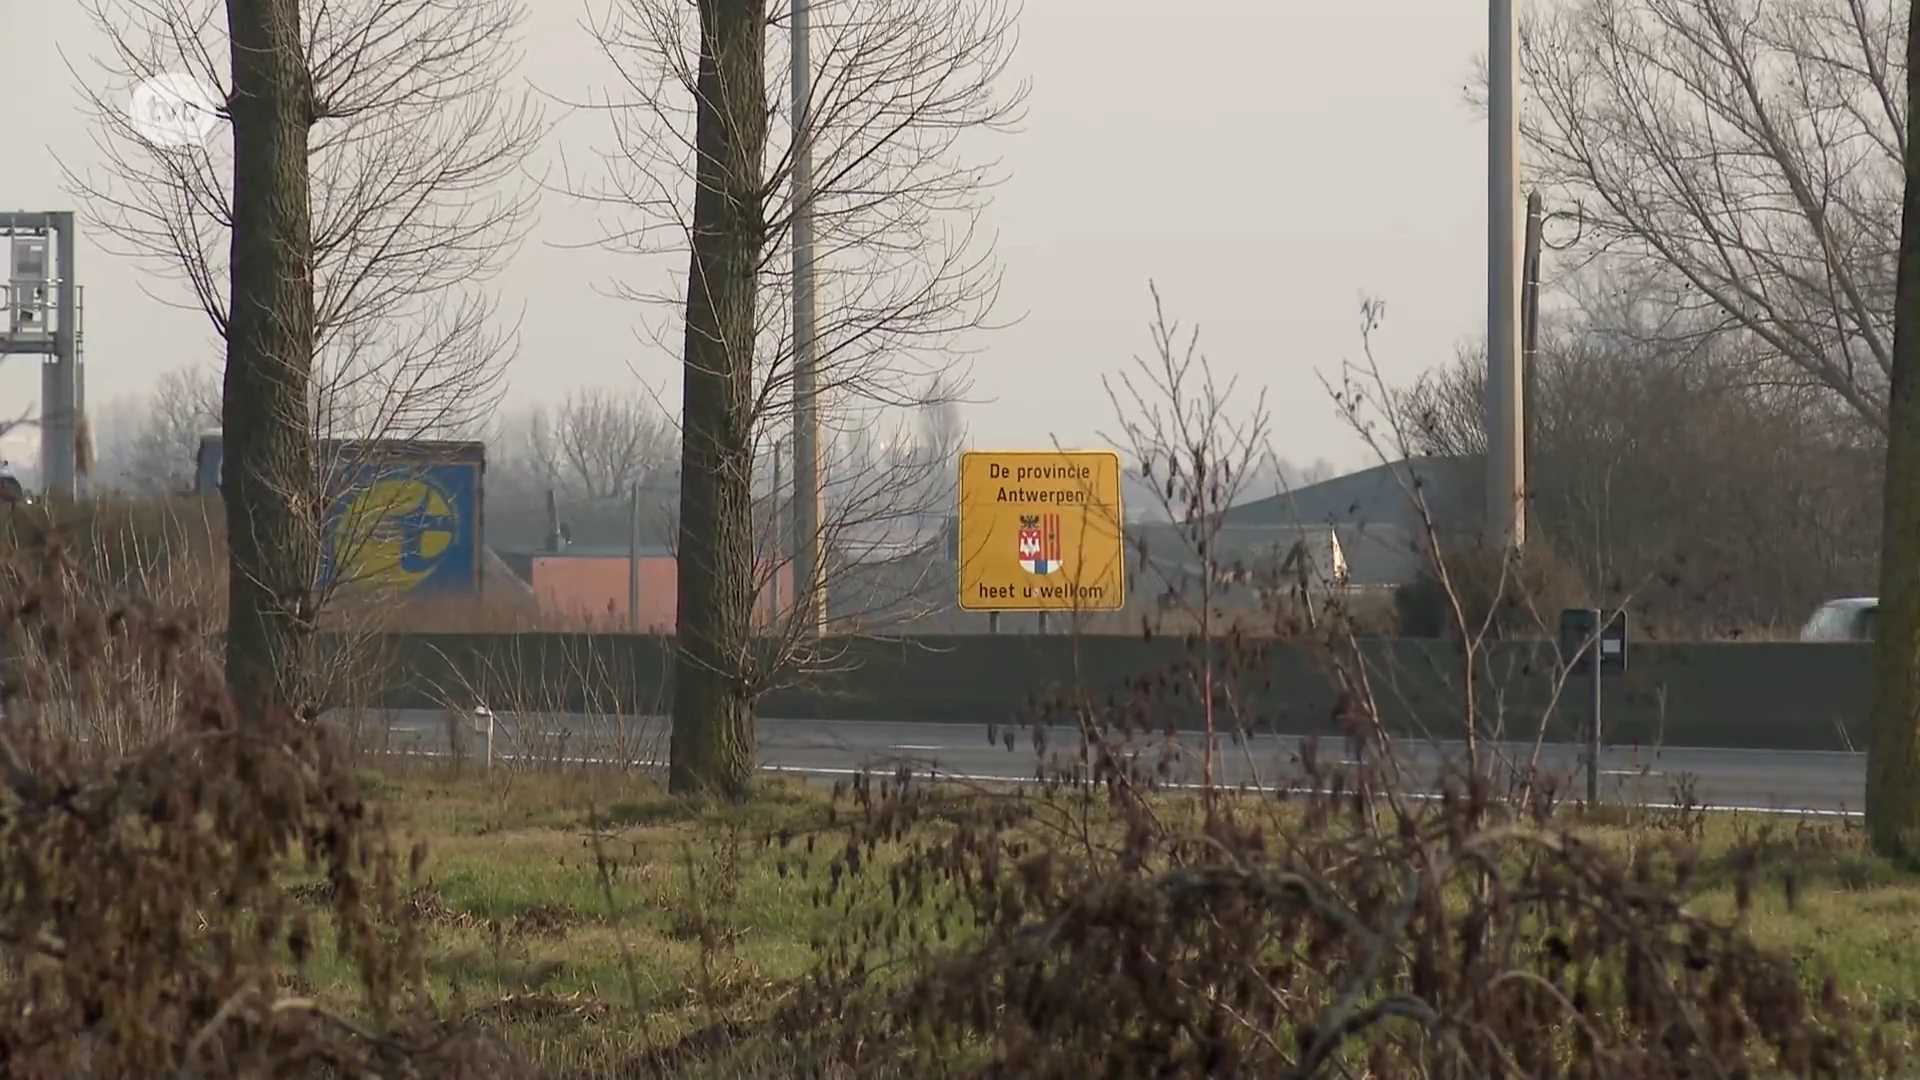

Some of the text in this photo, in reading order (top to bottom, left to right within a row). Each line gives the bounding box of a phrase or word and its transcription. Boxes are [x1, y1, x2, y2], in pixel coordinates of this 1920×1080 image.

[989, 463, 1091, 483] De provincie
[996, 487, 1085, 505] Antwerpen
[979, 582, 1015, 599] heet
[1023, 586, 1032, 599] u
